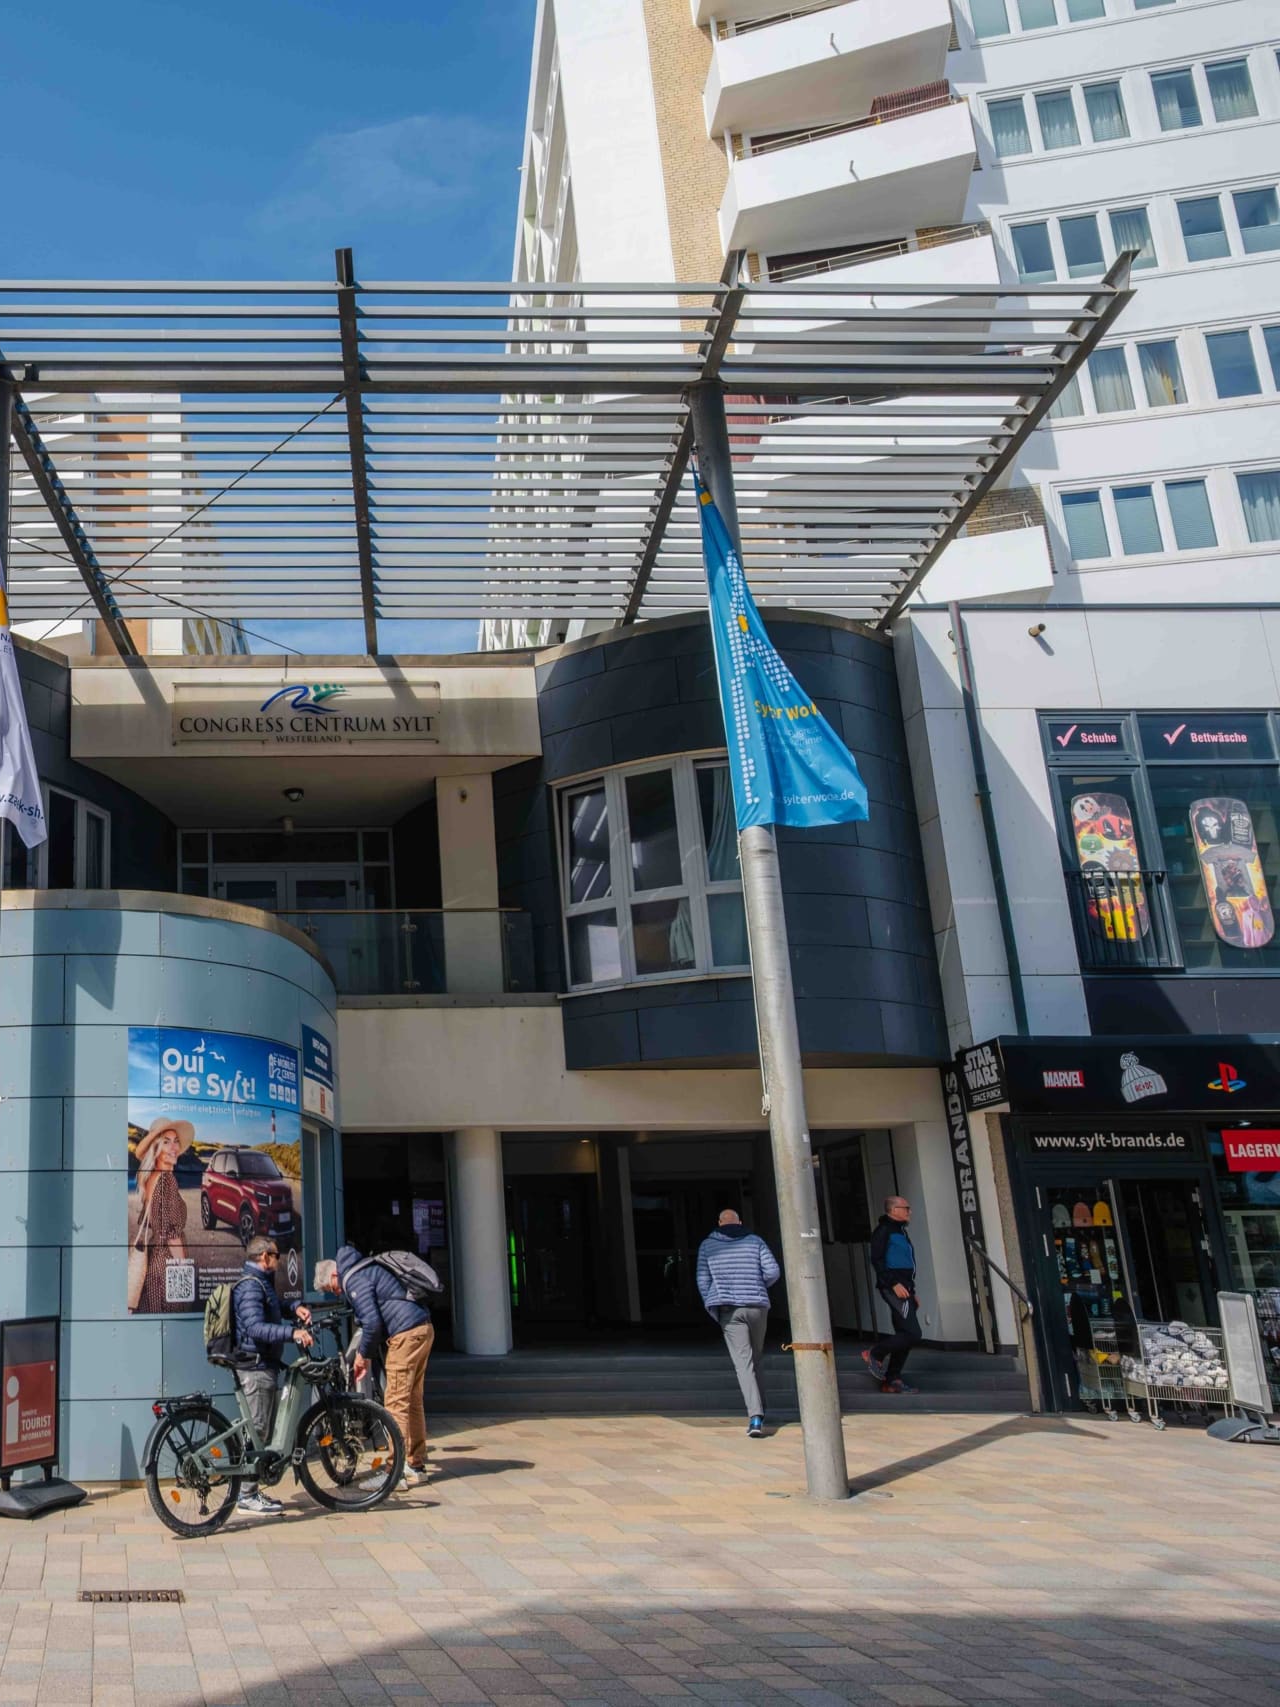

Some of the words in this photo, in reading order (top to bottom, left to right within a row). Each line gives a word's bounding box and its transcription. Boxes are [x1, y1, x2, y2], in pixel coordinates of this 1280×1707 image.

[179, 716, 284, 733] CONGRESS
[290, 716, 387, 733] CENTRUM
[393, 716, 434, 732] SYLT
[275, 735, 342, 743] WESTERLAND
[1080, 732, 1118, 744] Schuhe
[1190, 732, 1248, 743] Bettwäsche
[162, 1047, 204, 1074] Oui
[963, 1046, 996, 1073] STAR
[965, 1063, 999, 1090] WARS
[1042, 1071, 1084, 1088] MARVEL
[162, 1075, 200, 1096] are
[1034, 1132, 1185, 1151] www.sylt-brands.de
[22, 1415, 51, 1431] TOURIST
